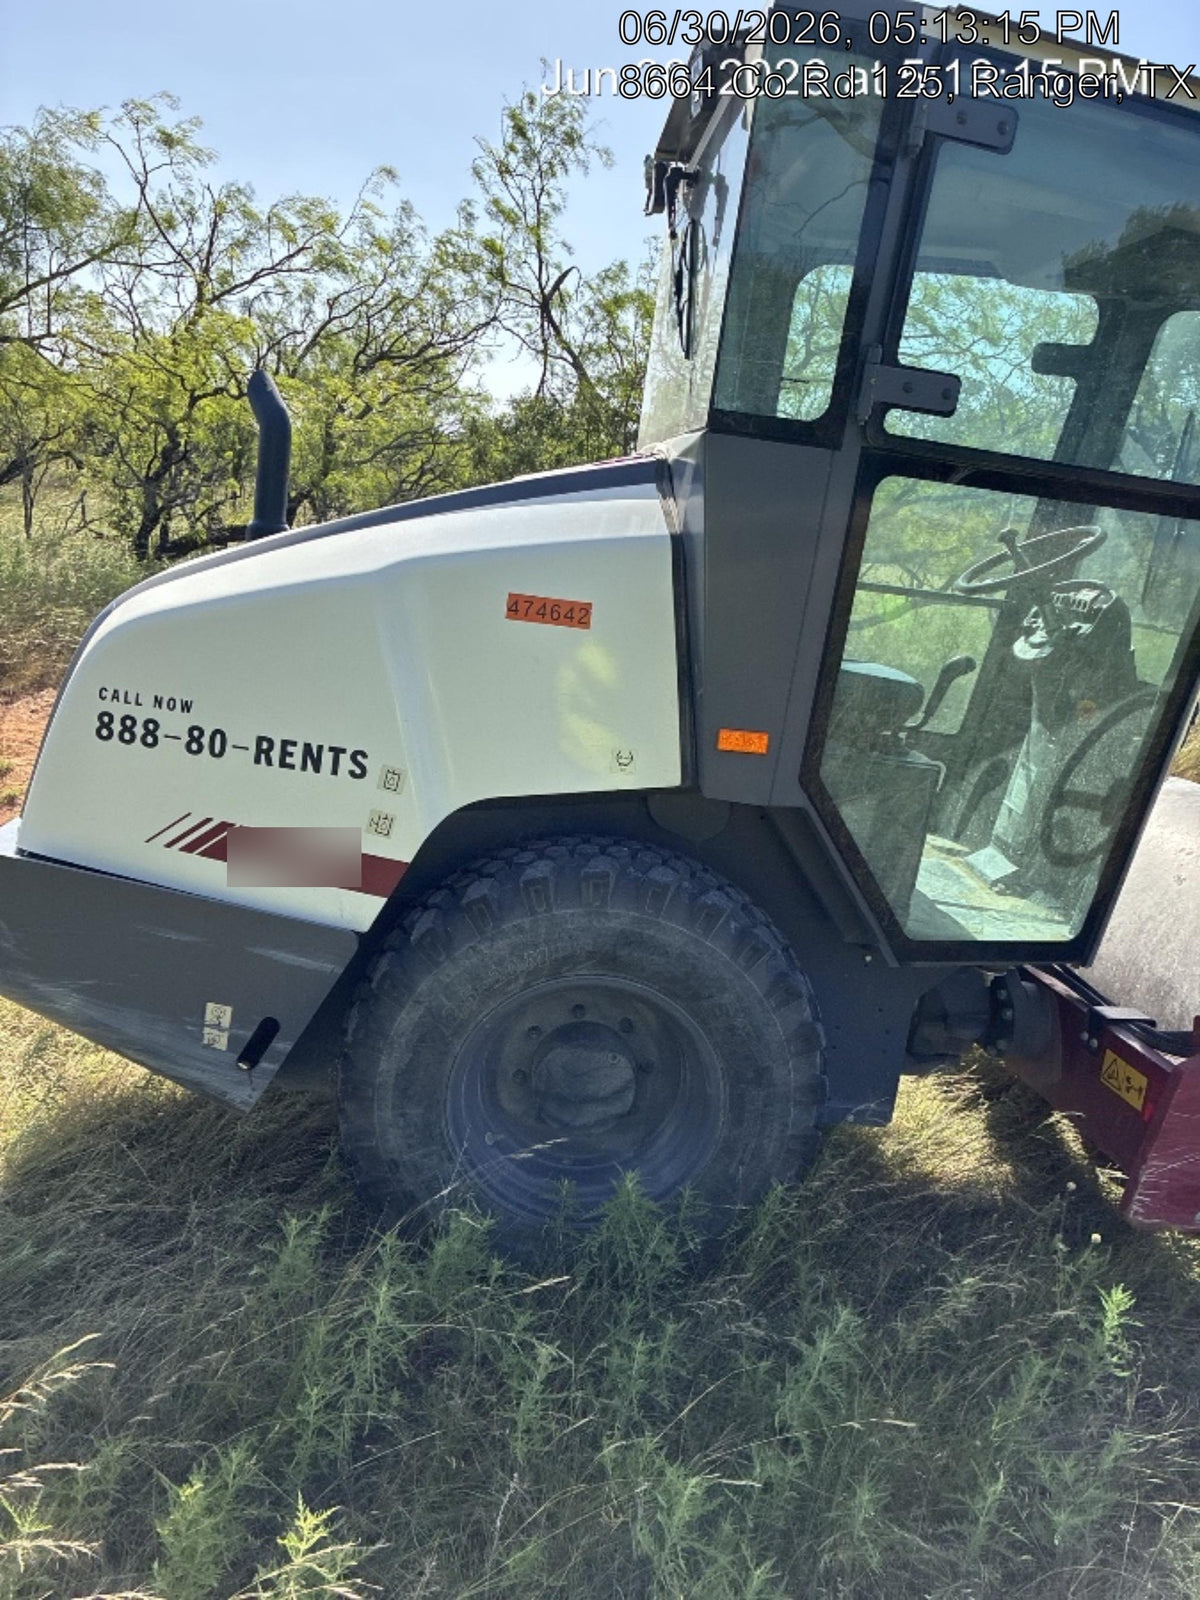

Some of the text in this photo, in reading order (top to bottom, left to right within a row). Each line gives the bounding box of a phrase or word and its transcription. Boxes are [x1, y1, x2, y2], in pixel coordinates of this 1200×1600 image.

[506, 599, 590, 625] 474642
[98, 686, 194, 714] CALL NOW
[95, 710, 369, 780] 888-80-RENTS
